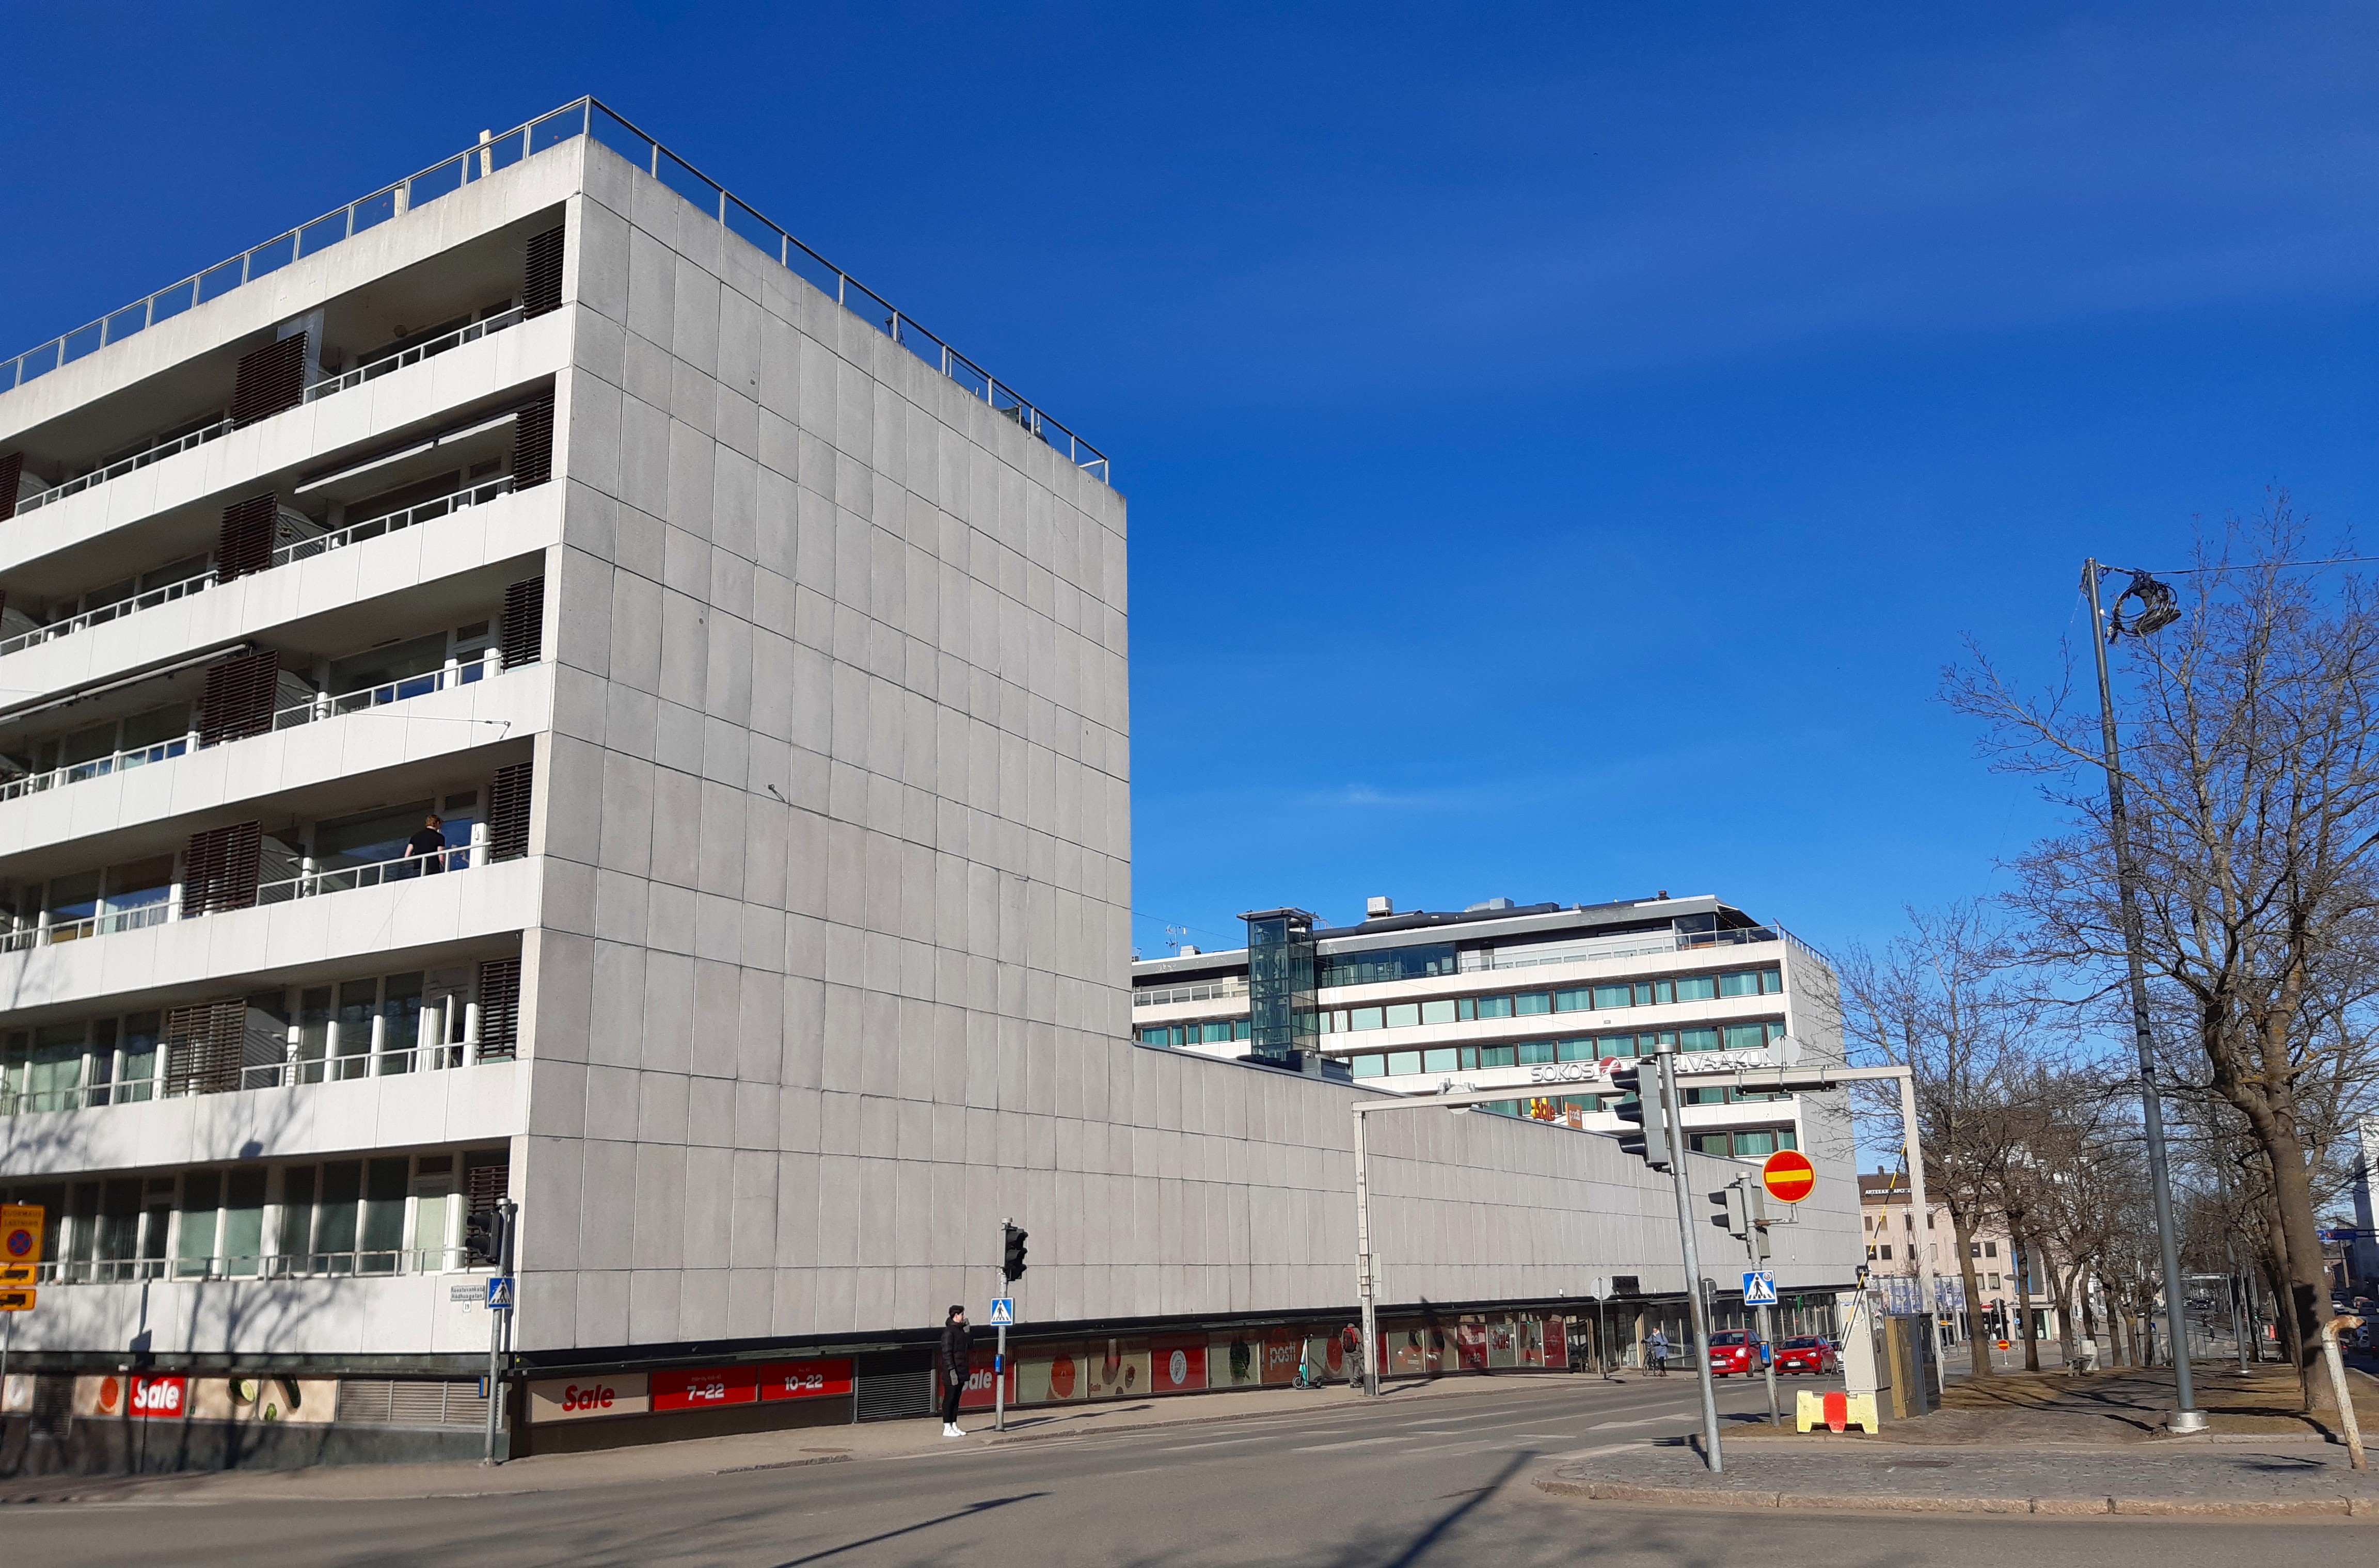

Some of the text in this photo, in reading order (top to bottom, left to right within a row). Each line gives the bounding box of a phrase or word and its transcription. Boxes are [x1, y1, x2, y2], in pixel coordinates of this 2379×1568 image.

[1531, 1063, 1595, 1082] SOKOS
[1688, 1049, 1789, 1071] VAAKUN
[1270, 1341, 1296, 1371] posti
[134, 1379, 179, 1410] Sale
[562, 1384, 615, 1412] Sale
